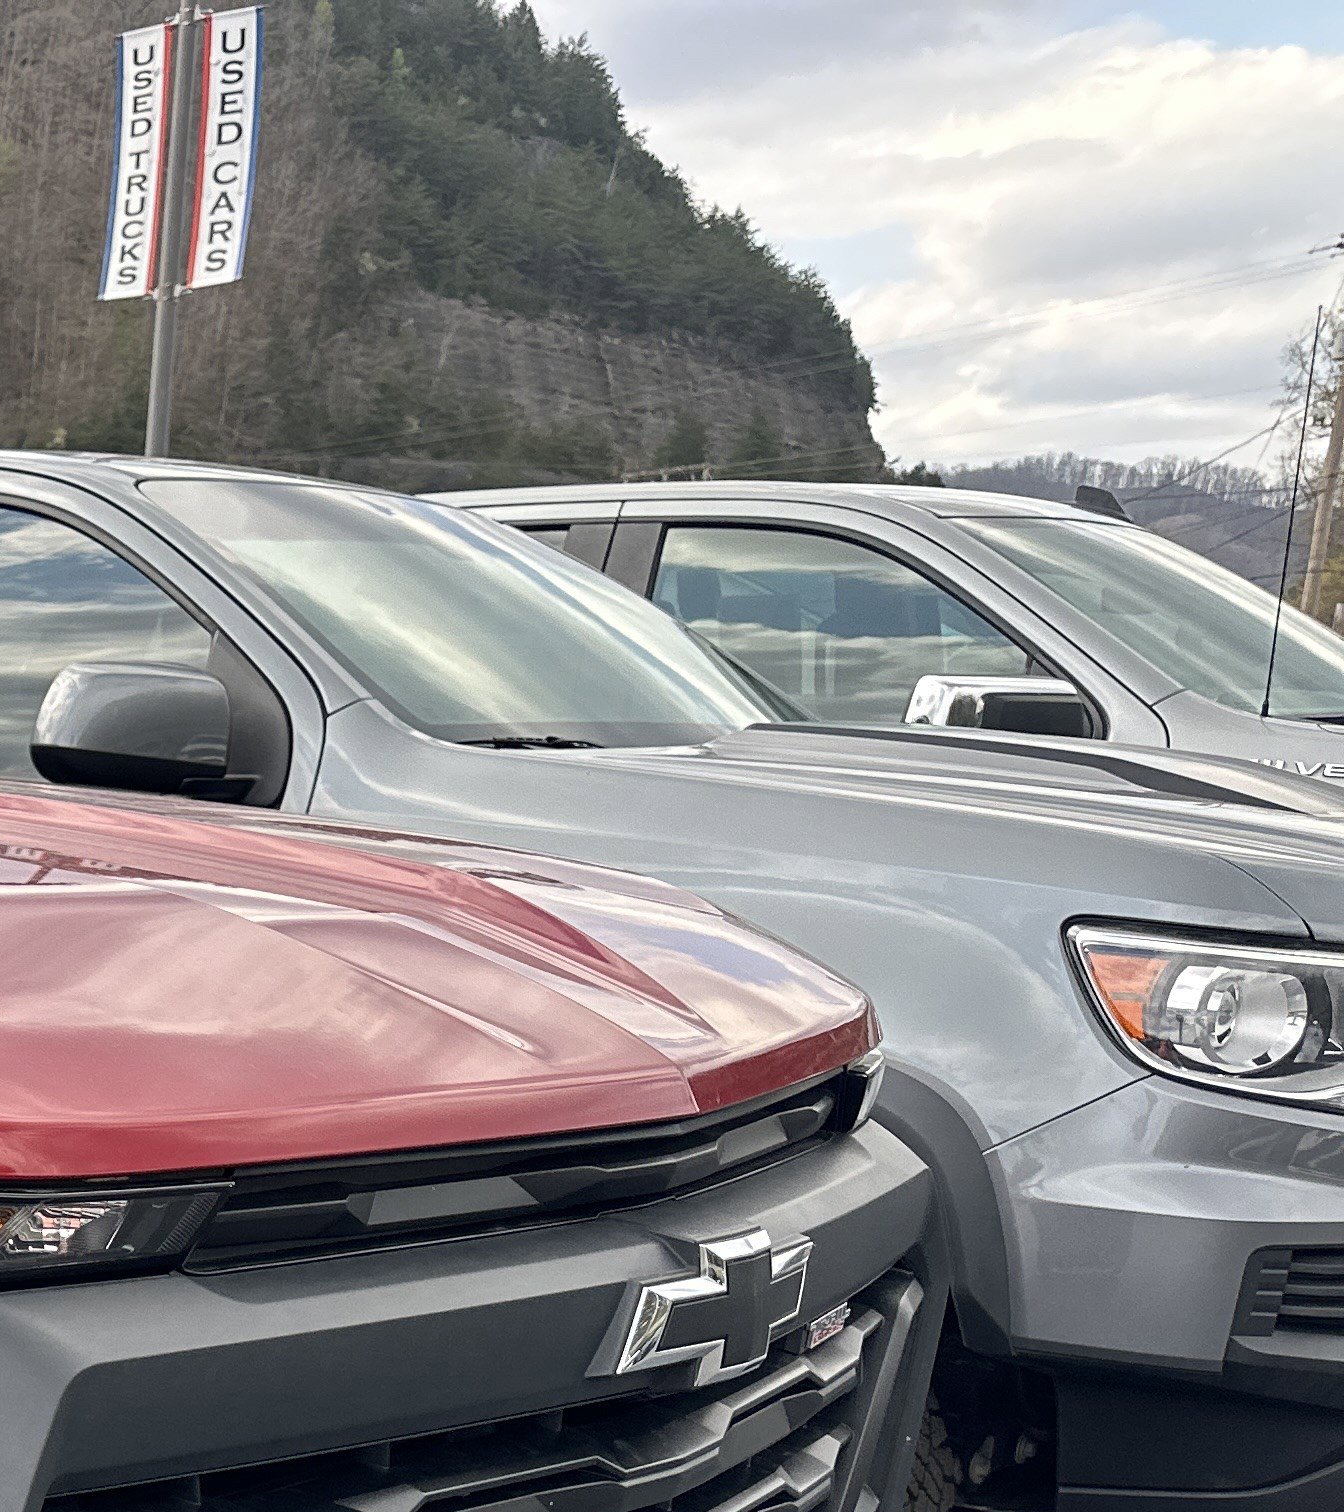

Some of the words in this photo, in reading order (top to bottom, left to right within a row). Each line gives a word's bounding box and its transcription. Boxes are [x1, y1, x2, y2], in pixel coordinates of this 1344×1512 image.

[130, 45, 155, 138] USED
[217, 28, 246, 146] USED
[117, 149, 150, 286] TRUCKS
[205, 160, 239, 273] CARS
